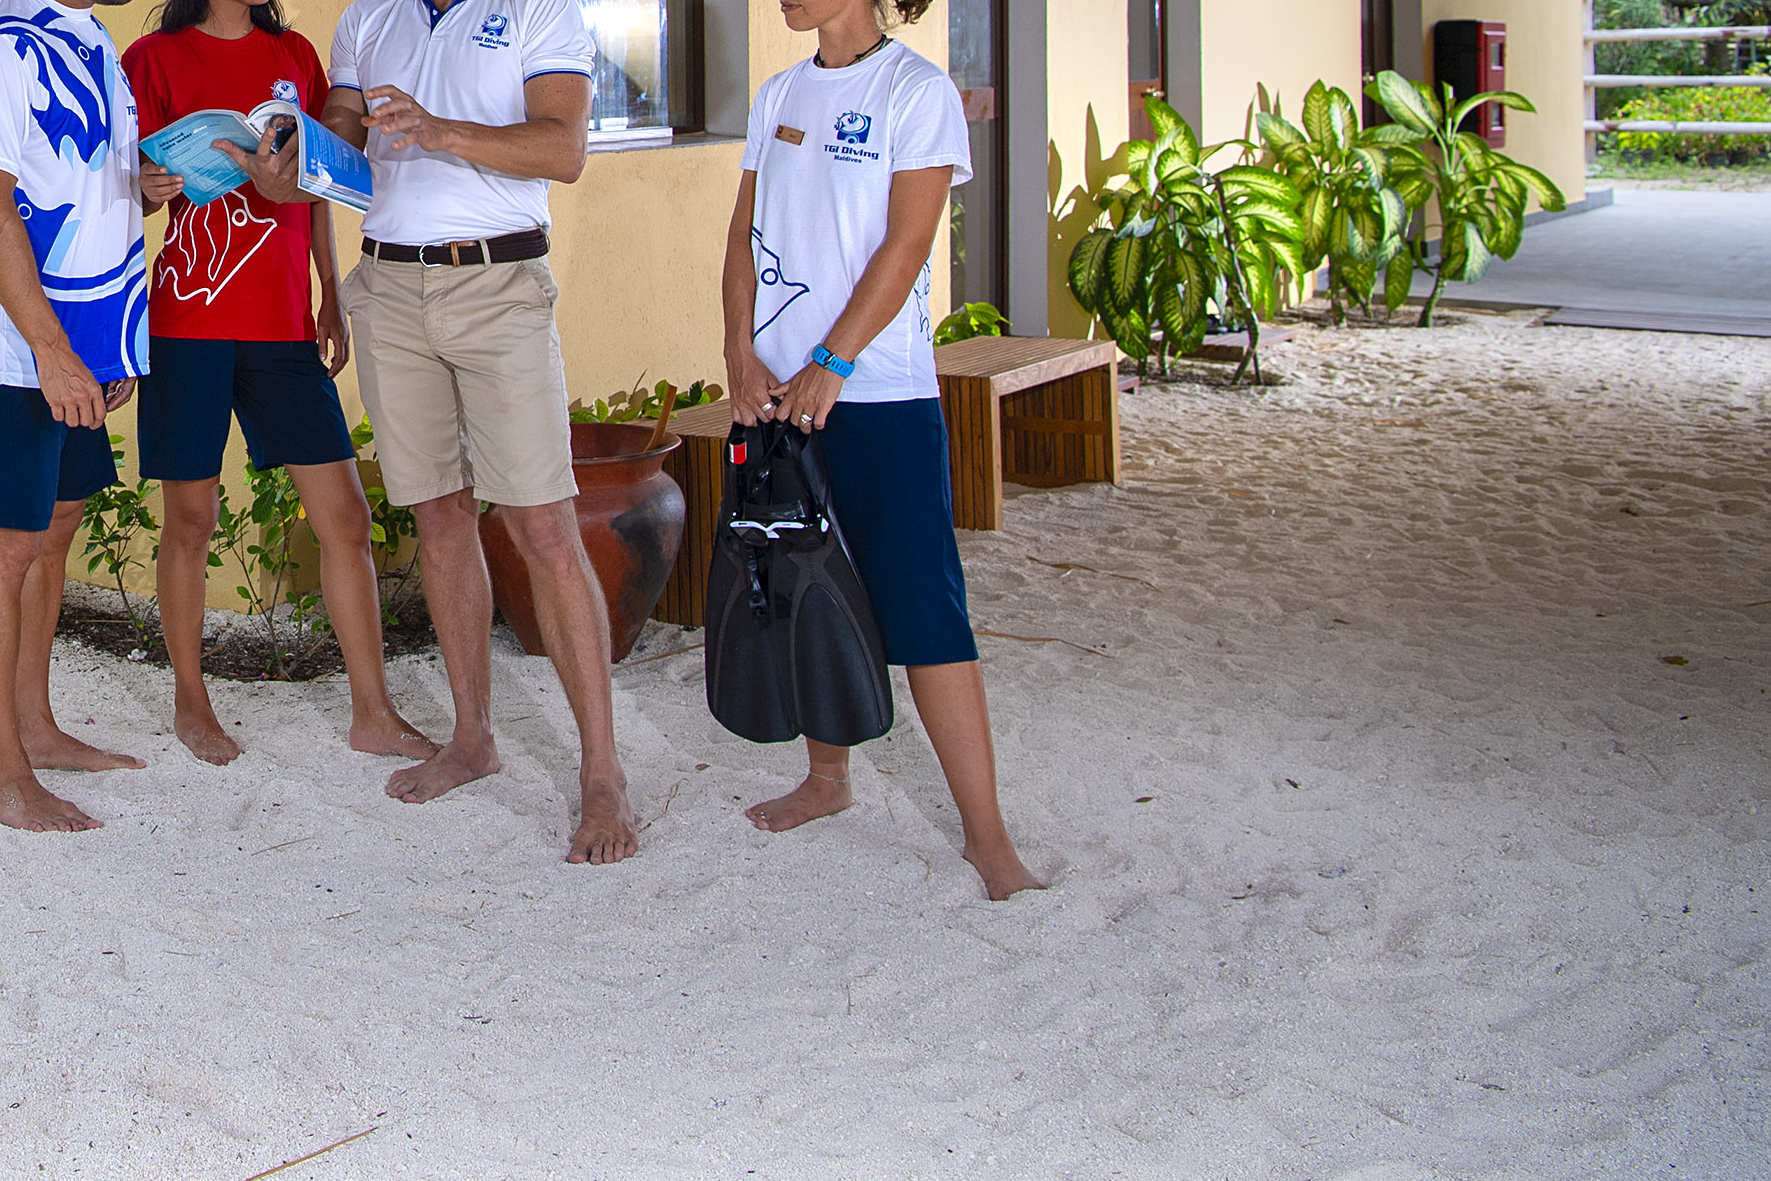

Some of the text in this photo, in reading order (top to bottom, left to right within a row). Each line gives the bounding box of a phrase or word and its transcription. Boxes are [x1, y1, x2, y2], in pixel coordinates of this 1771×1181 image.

[484, 37, 510, 48] Diving
[823, 144, 880, 160] TGI Diving
[833, 154, 863, 163] Maldives
